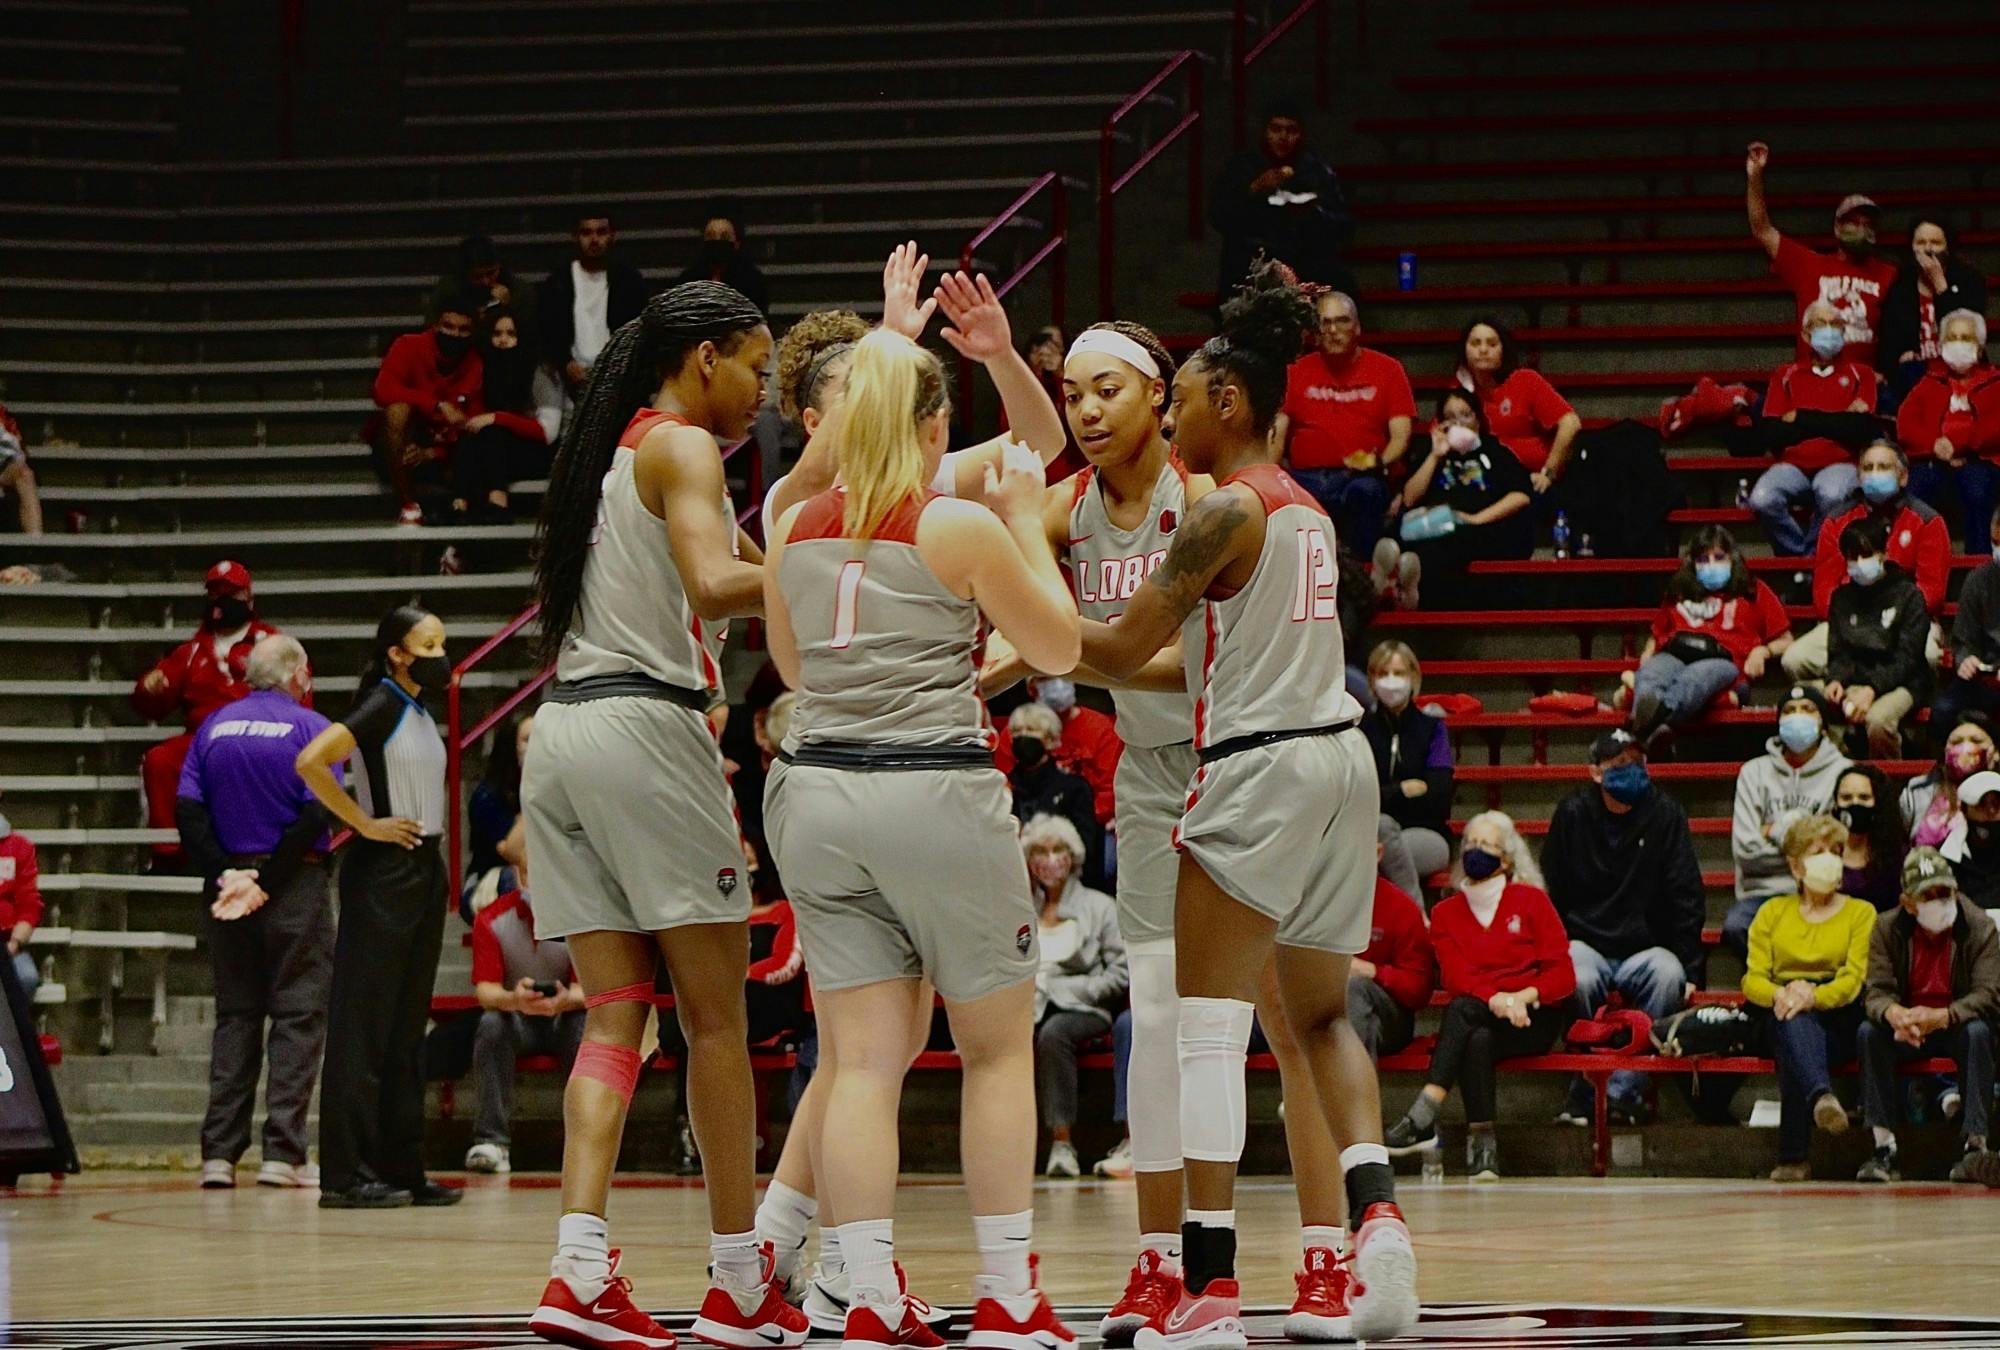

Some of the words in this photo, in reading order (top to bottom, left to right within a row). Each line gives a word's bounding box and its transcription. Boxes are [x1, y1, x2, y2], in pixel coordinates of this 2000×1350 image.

[830, 560, 866, 650] 1
[1078, 549, 1168, 603] LOB
[1291, 527, 1336, 623] 12
